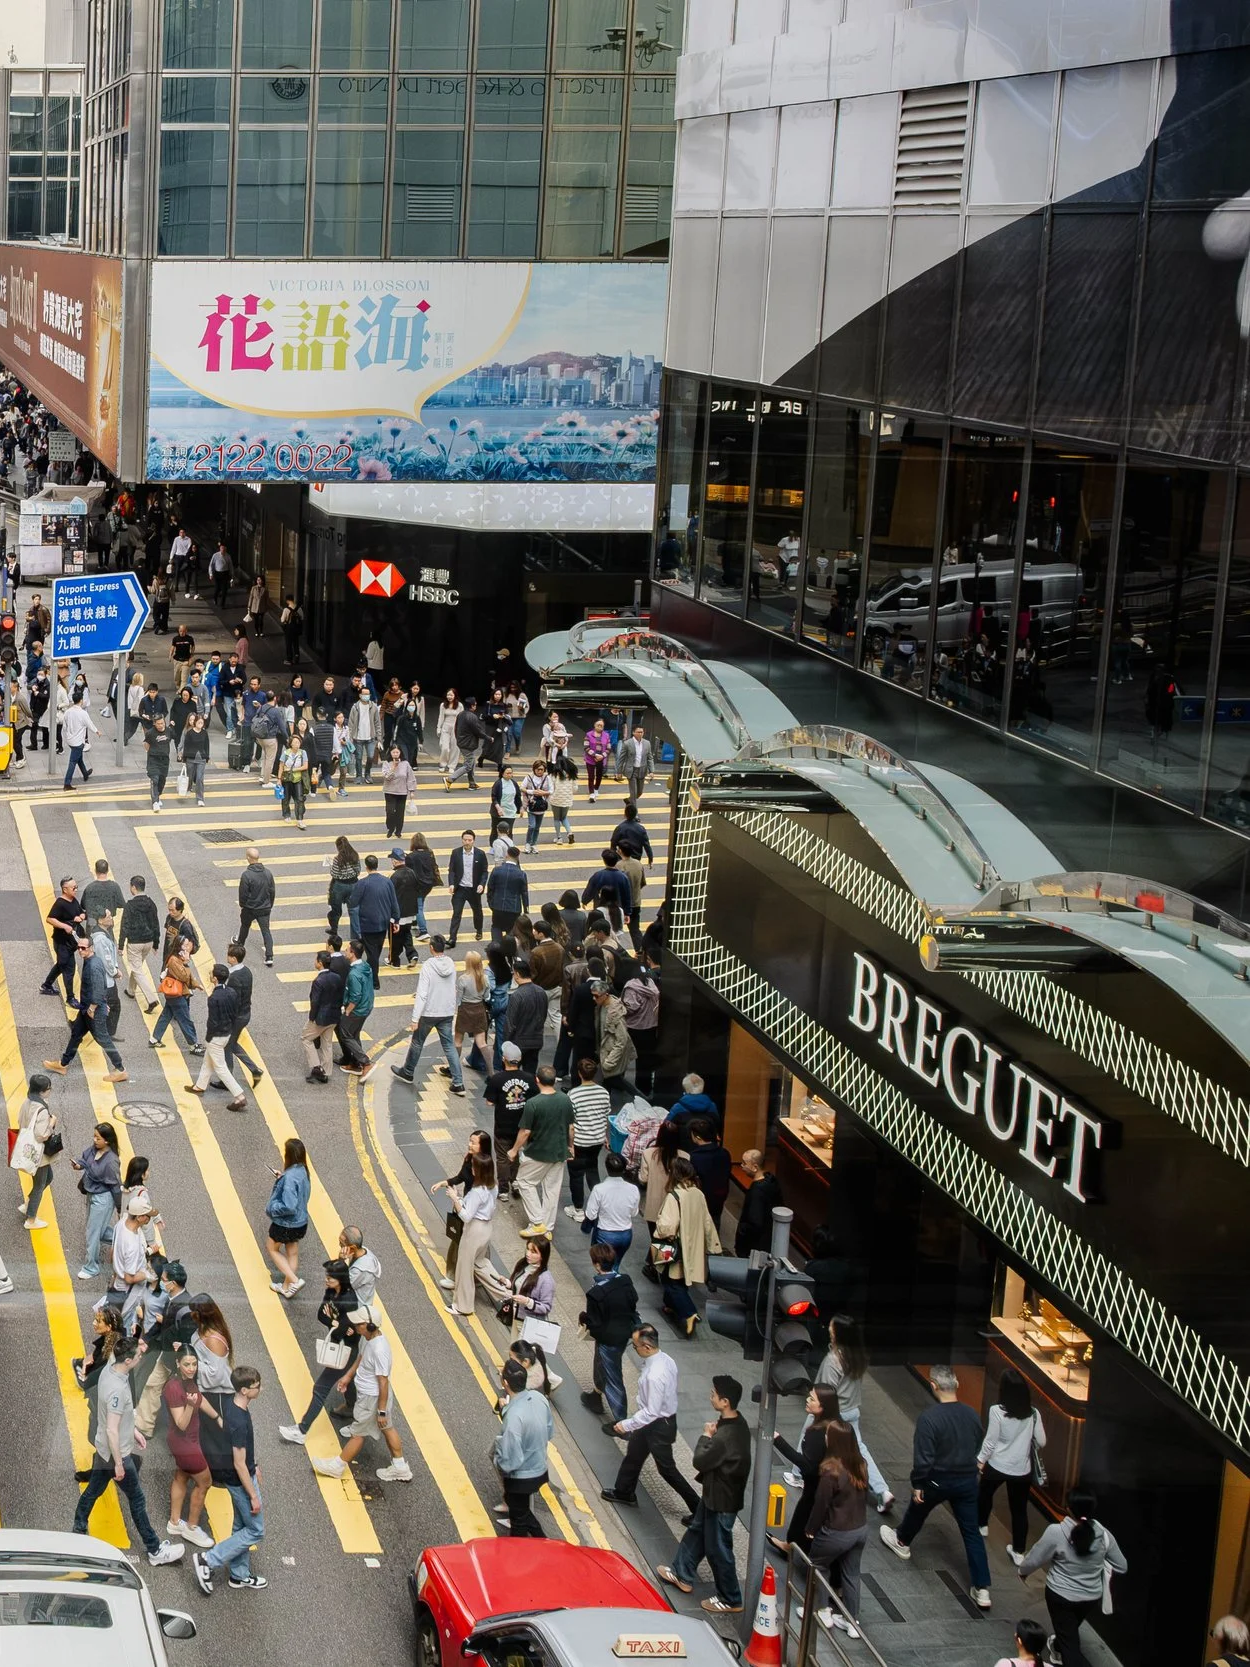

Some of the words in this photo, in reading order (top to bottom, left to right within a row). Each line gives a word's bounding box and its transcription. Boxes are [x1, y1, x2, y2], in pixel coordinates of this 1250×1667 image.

[268, 279, 346, 292] VICTORIA
[352, 279, 431, 292] BLOSSOM
[193, 444, 265, 472] 2122
[274, 444, 352, 472] 0022
[58, 584, 87, 595] Airport
[89, 582, 120, 592] Express
[408, 584, 460, 606] HSBC
[58, 596, 92, 607] Station
[56, 623, 97, 635] Kowloon
[57, 636, 81, 650] 九龍
[848, 952, 1102, 1203] BREGUET
[626, 1640, 680, 1653] TAXI
